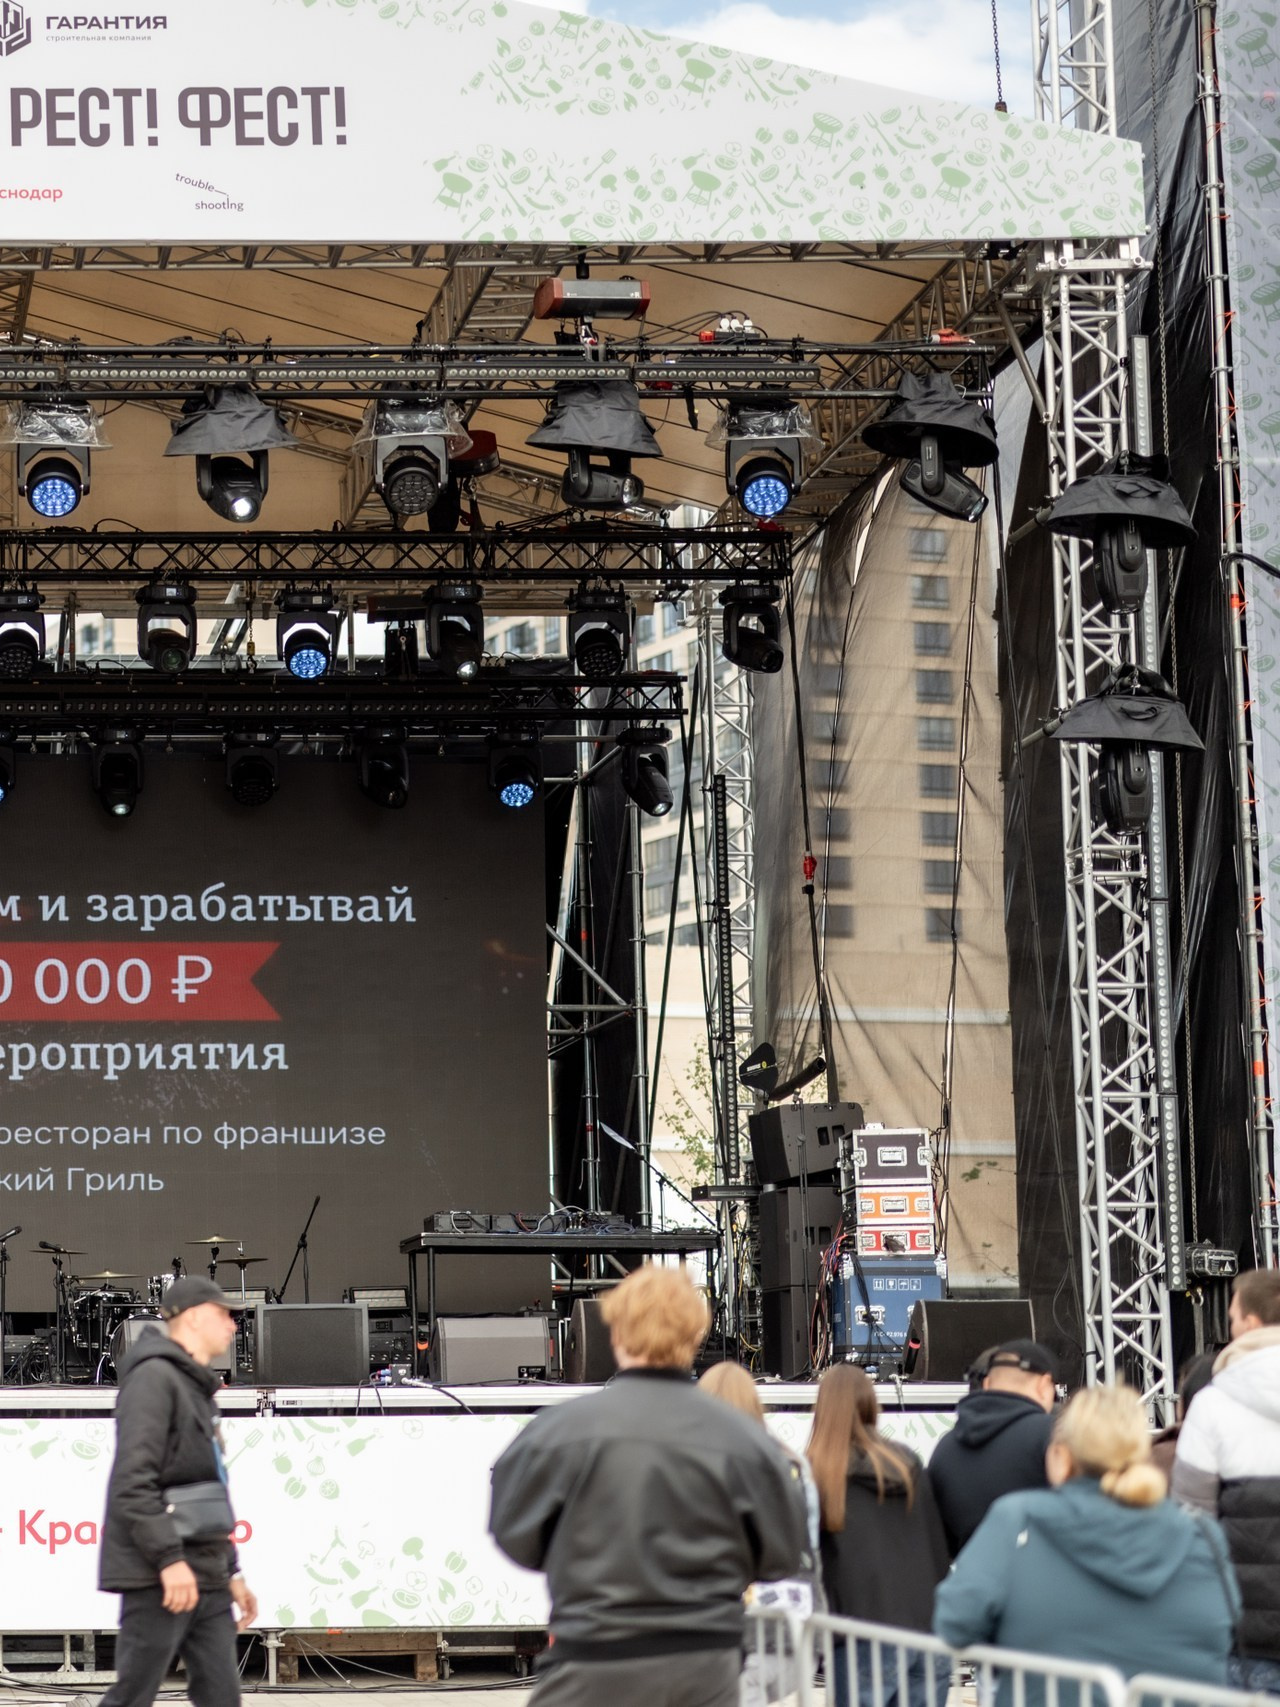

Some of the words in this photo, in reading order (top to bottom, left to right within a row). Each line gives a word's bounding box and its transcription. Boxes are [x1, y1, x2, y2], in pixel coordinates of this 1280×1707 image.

[46, 15, 168, 30] ГАРАНТИЯ
[45, 35, 107, 43] строительная
[9, 87, 159, 148] РЕСТ!
[177, 85, 348, 147] ФЕСТ!
[175, 172, 215, 192] trouble
[195, 196, 244, 212] shooting
[39, 895, 70, 921] и
[86, 882, 417, 932] зарабатывай
[34, 958, 152, 1005] 000
[163, 1126, 202, 1145] по
[213, 1121, 387, 1150] франшизе
[67, 1167, 164, 1197] Гриль
